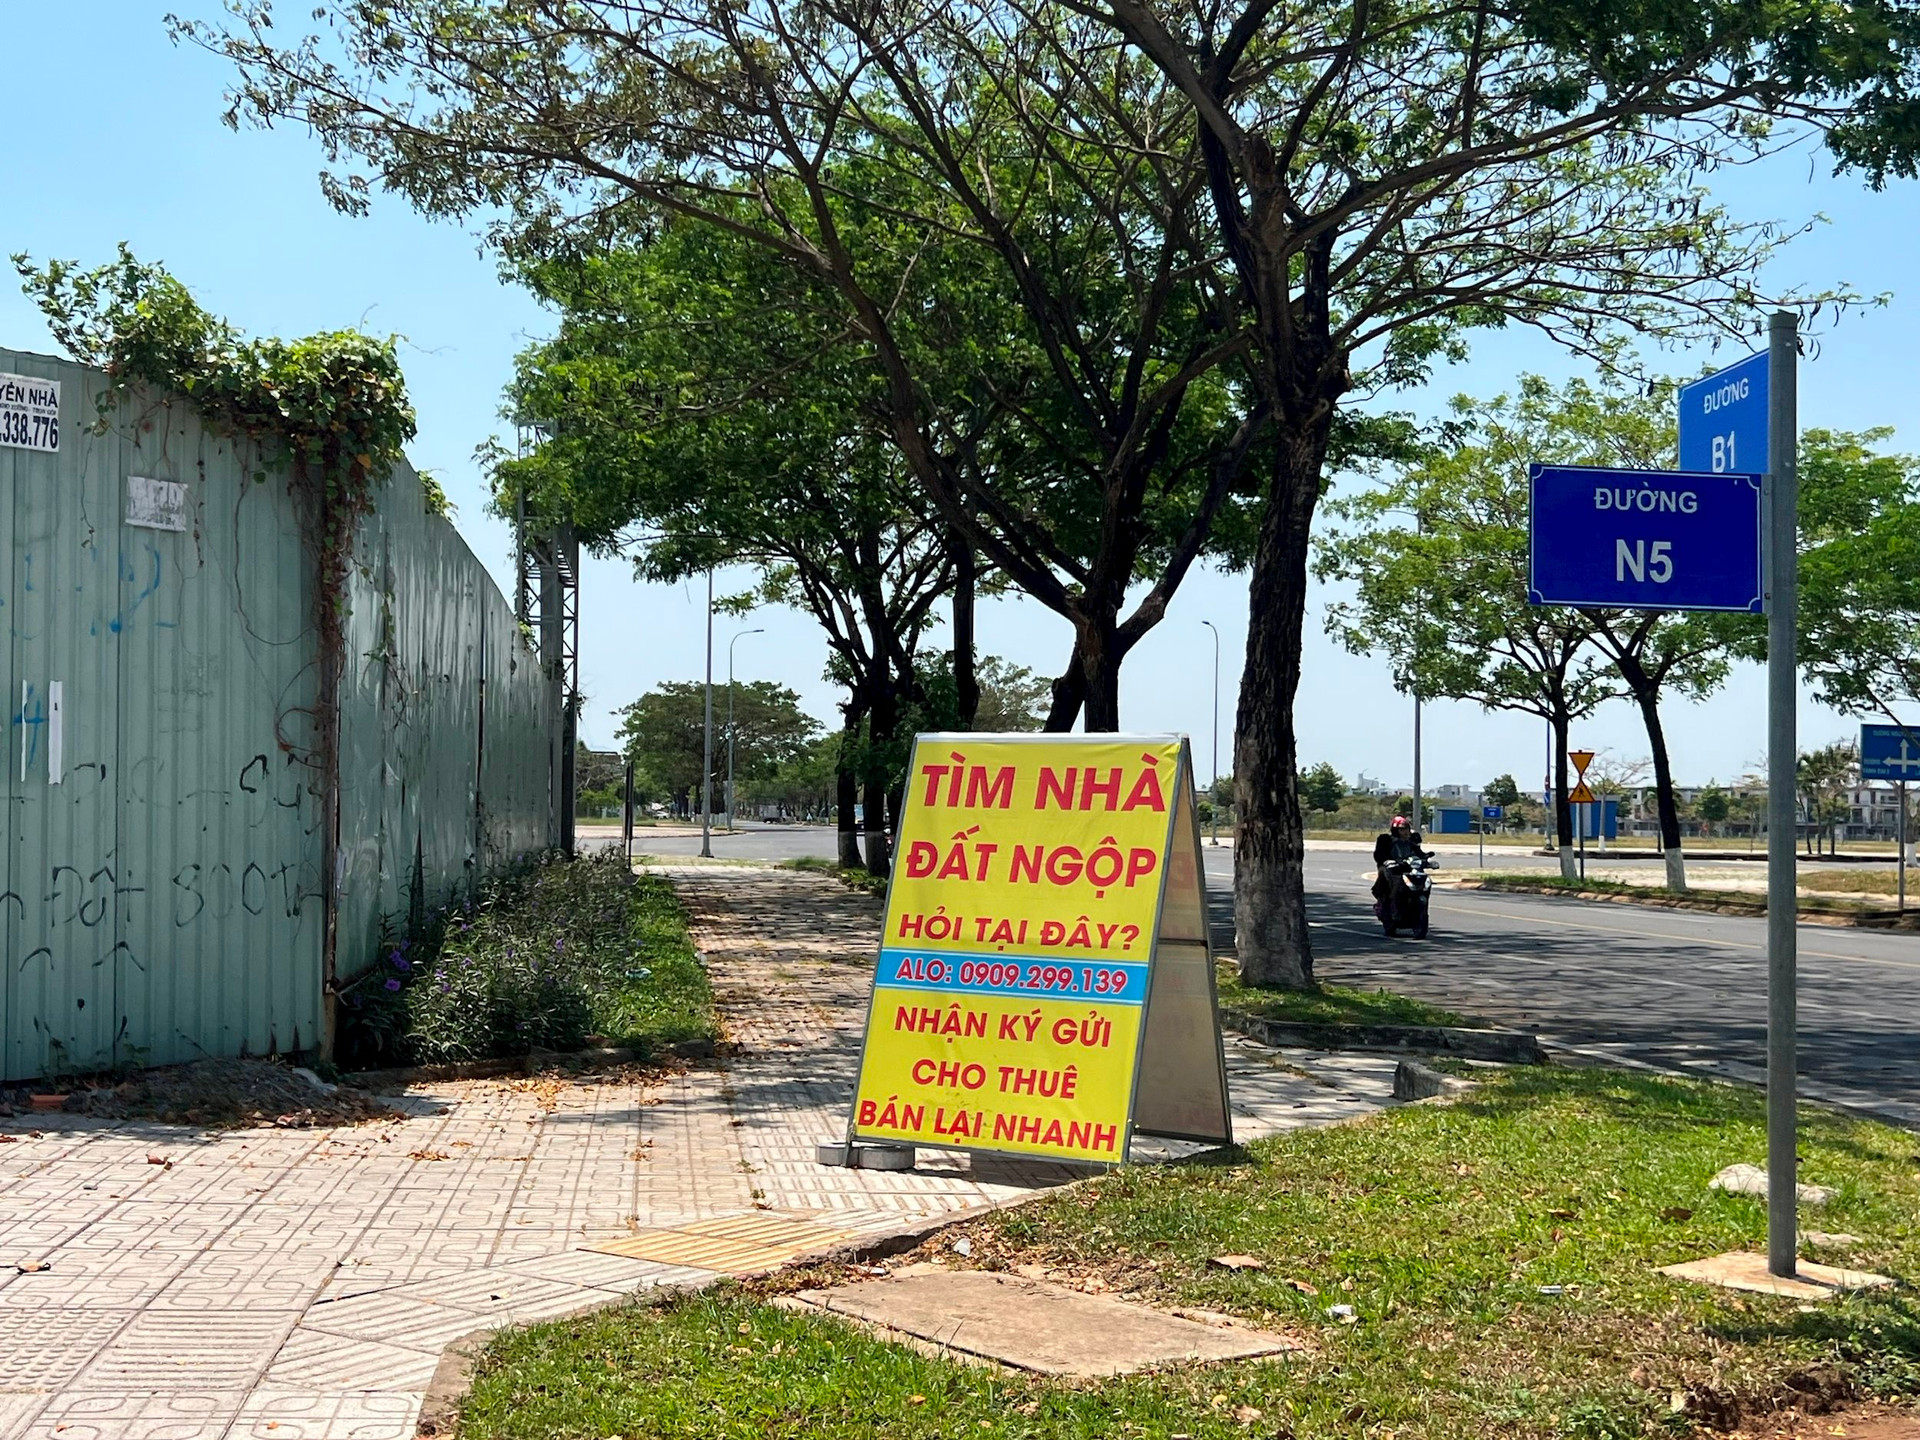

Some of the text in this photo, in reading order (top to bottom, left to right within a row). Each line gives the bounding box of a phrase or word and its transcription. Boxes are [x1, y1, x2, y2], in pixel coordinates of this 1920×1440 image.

[29, 387, 58, 408] NHÀ
[1704, 377, 1749, 415] ĐƯỜNG
[1711, 431, 1735, 473] B1
[1594, 481, 1698, 514] ĐƯỜNG
[1616, 539, 1673, 583] N5
[922, 751, 1166, 812] TÌM NHÀ
[906, 825, 1157, 898] ĐẤT NGỘP
[899, 906, 1140, 951] HỎI TẠI ĐÂY?
[896, 957, 1128, 994] ALO: 0909.299.139
[894, 1002, 1112, 1048] NHẬN KÝ GỬI
[912, 1059, 1078, 1099] CHO THUÊ
[858, 1095, 1117, 1152] BÁN LẠI NHANH
